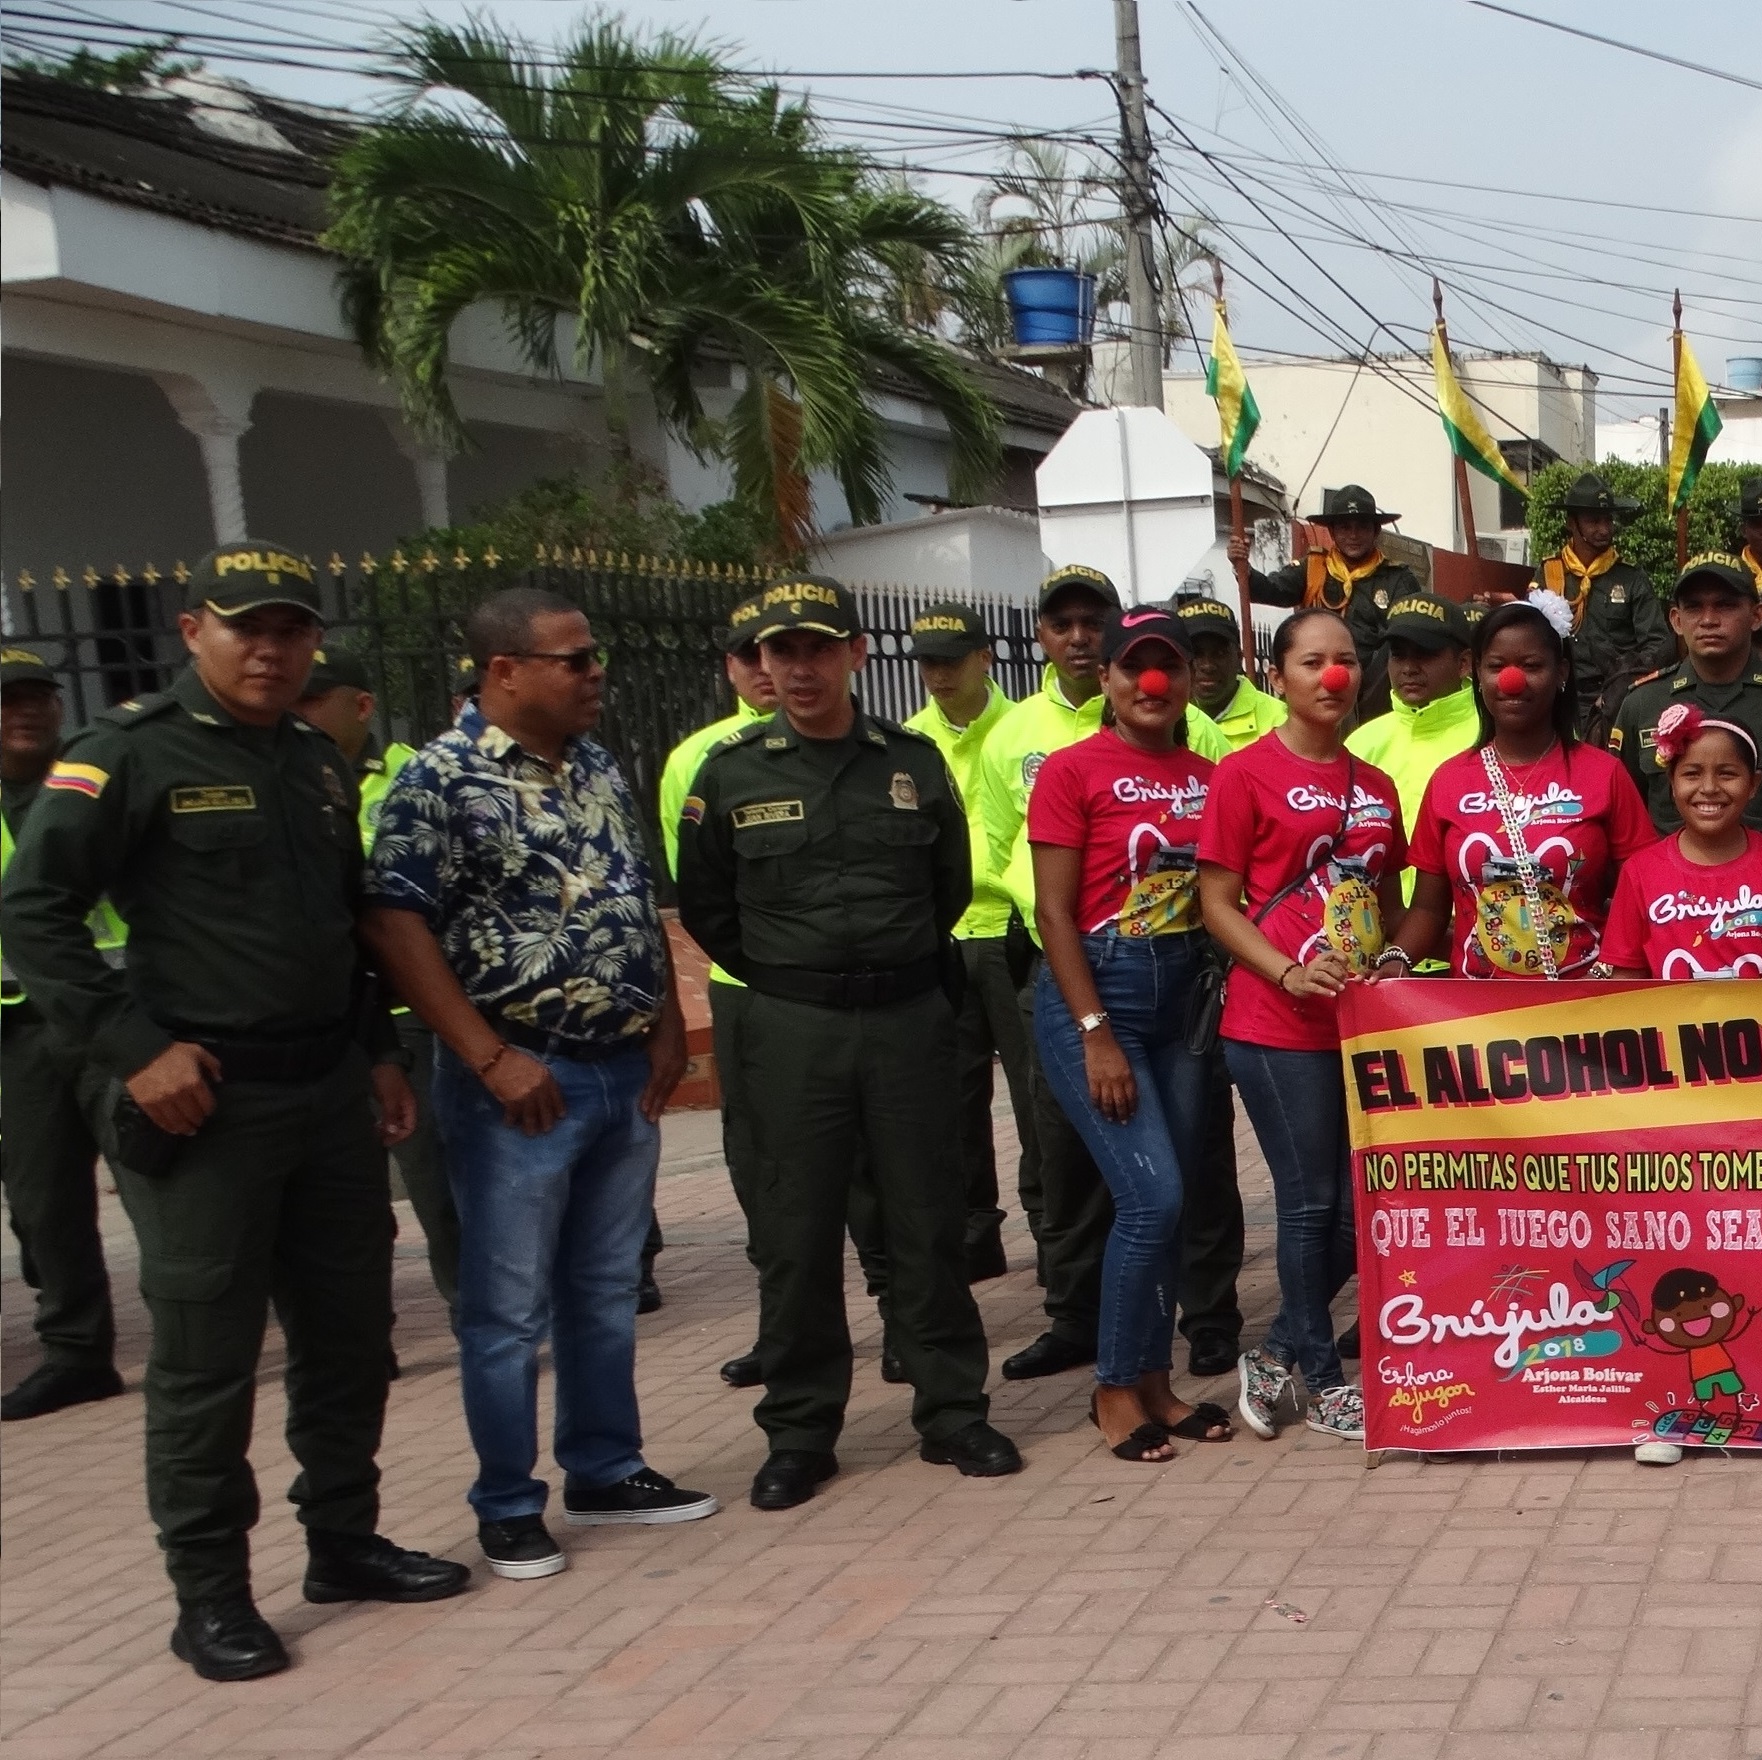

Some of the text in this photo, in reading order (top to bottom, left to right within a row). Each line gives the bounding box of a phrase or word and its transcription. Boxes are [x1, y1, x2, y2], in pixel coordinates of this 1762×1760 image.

[1681, 551, 1742, 576] POLICIA
[763, 582, 840, 610] POLICIA
[1386, 599, 1445, 622] POLICIA
[1351, 1049, 1420, 1114] EL
[1423, 1026, 1677, 1109] ALCOHOL
[1364, 1151, 1398, 1194] NO
[1403, 1150, 1519, 1194] PERMITAS
[1523, 1152, 1572, 1194] QUE
[1575, 1152, 1620, 1194] TUS
[1625, 1152, 1694, 1194] HIJOS
[1370, 1207, 1431, 1257] QUE
[1445, 1207, 1485, 1247] EL
[1498, 1208, 1592, 1249] JUEGO
[1606, 1209, 1692, 1251] SANO
[1378, 1282, 1614, 1368] Brújula
[1524, 1337, 1586, 1365] 2018
[1521, 1366, 1644, 1384] Arjona Bolívar
[1532, 1384, 1567, 1394] Esther
[1558, 1394, 1608, 1404] Alcaldesa
